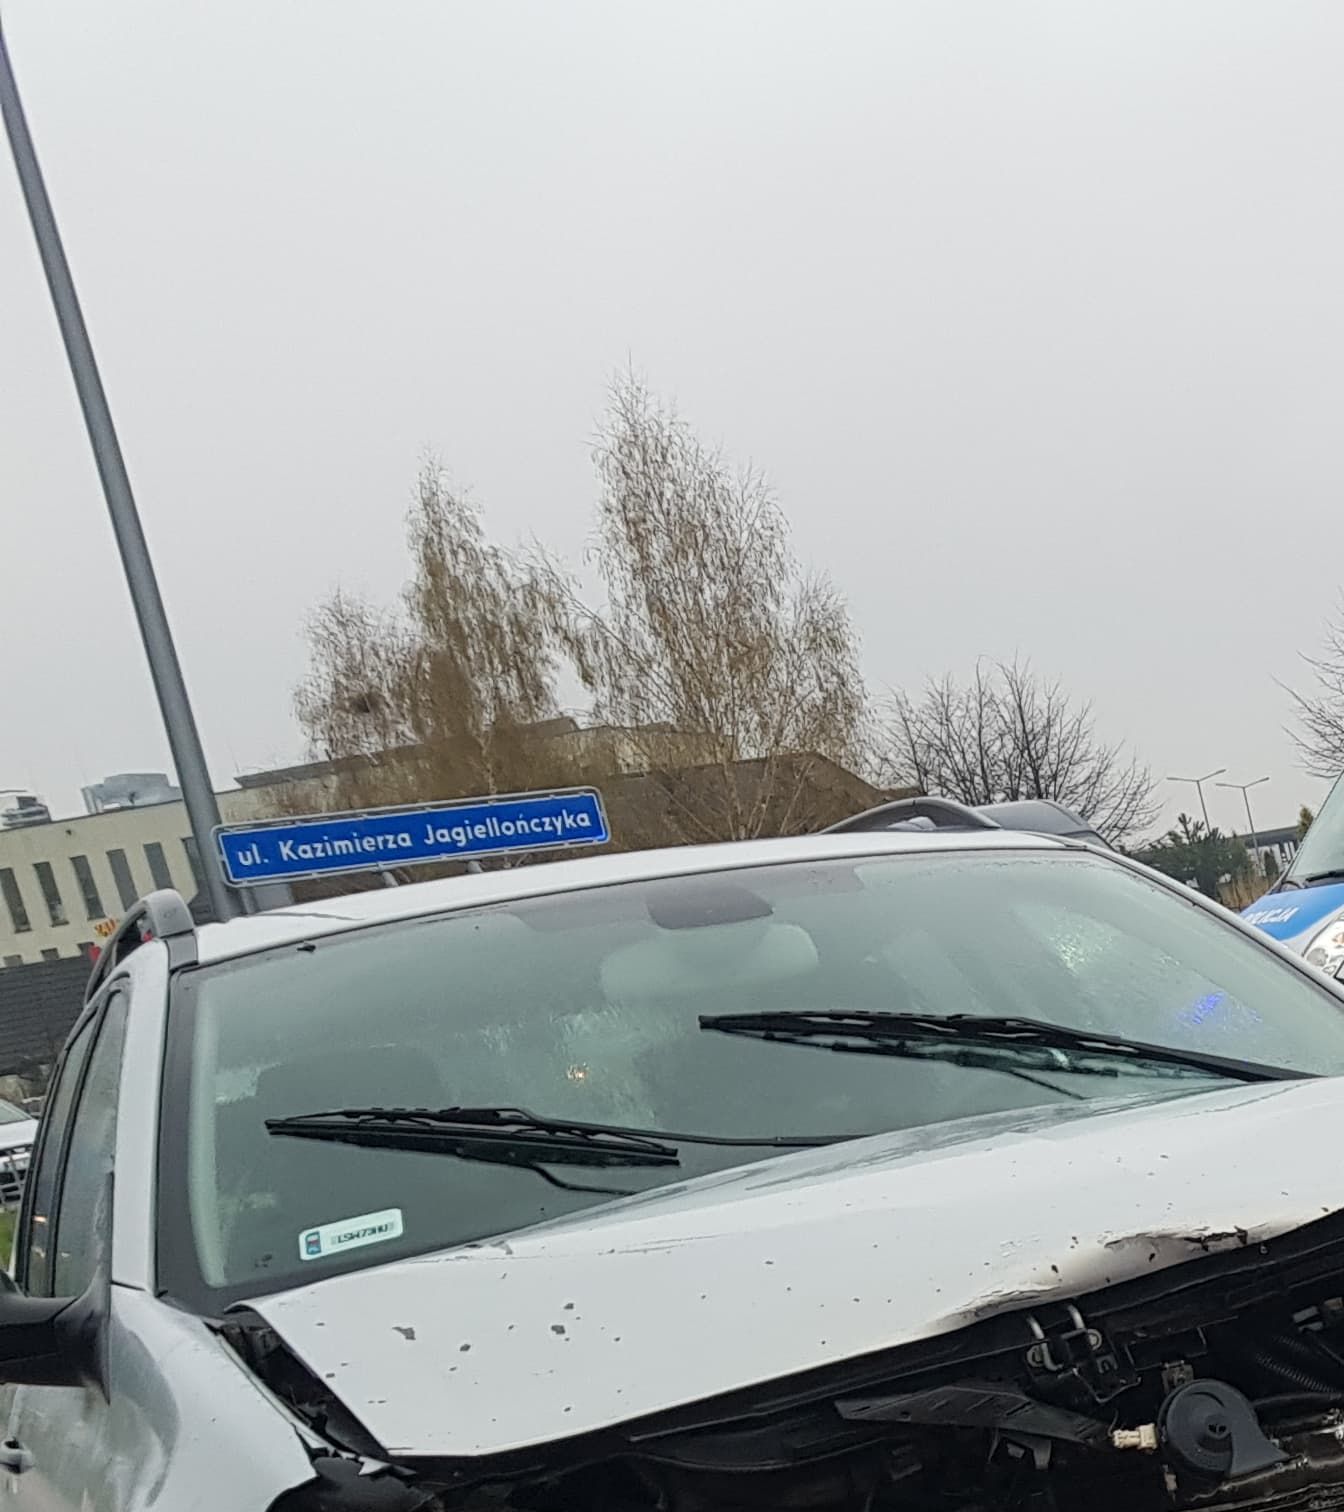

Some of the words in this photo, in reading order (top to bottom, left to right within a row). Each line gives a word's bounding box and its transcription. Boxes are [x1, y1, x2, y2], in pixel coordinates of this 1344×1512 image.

[236, 848, 269, 867] ul.
[279, 831, 413, 861] Kazimierza
[423, 808, 592, 847] Jagiellończyka
